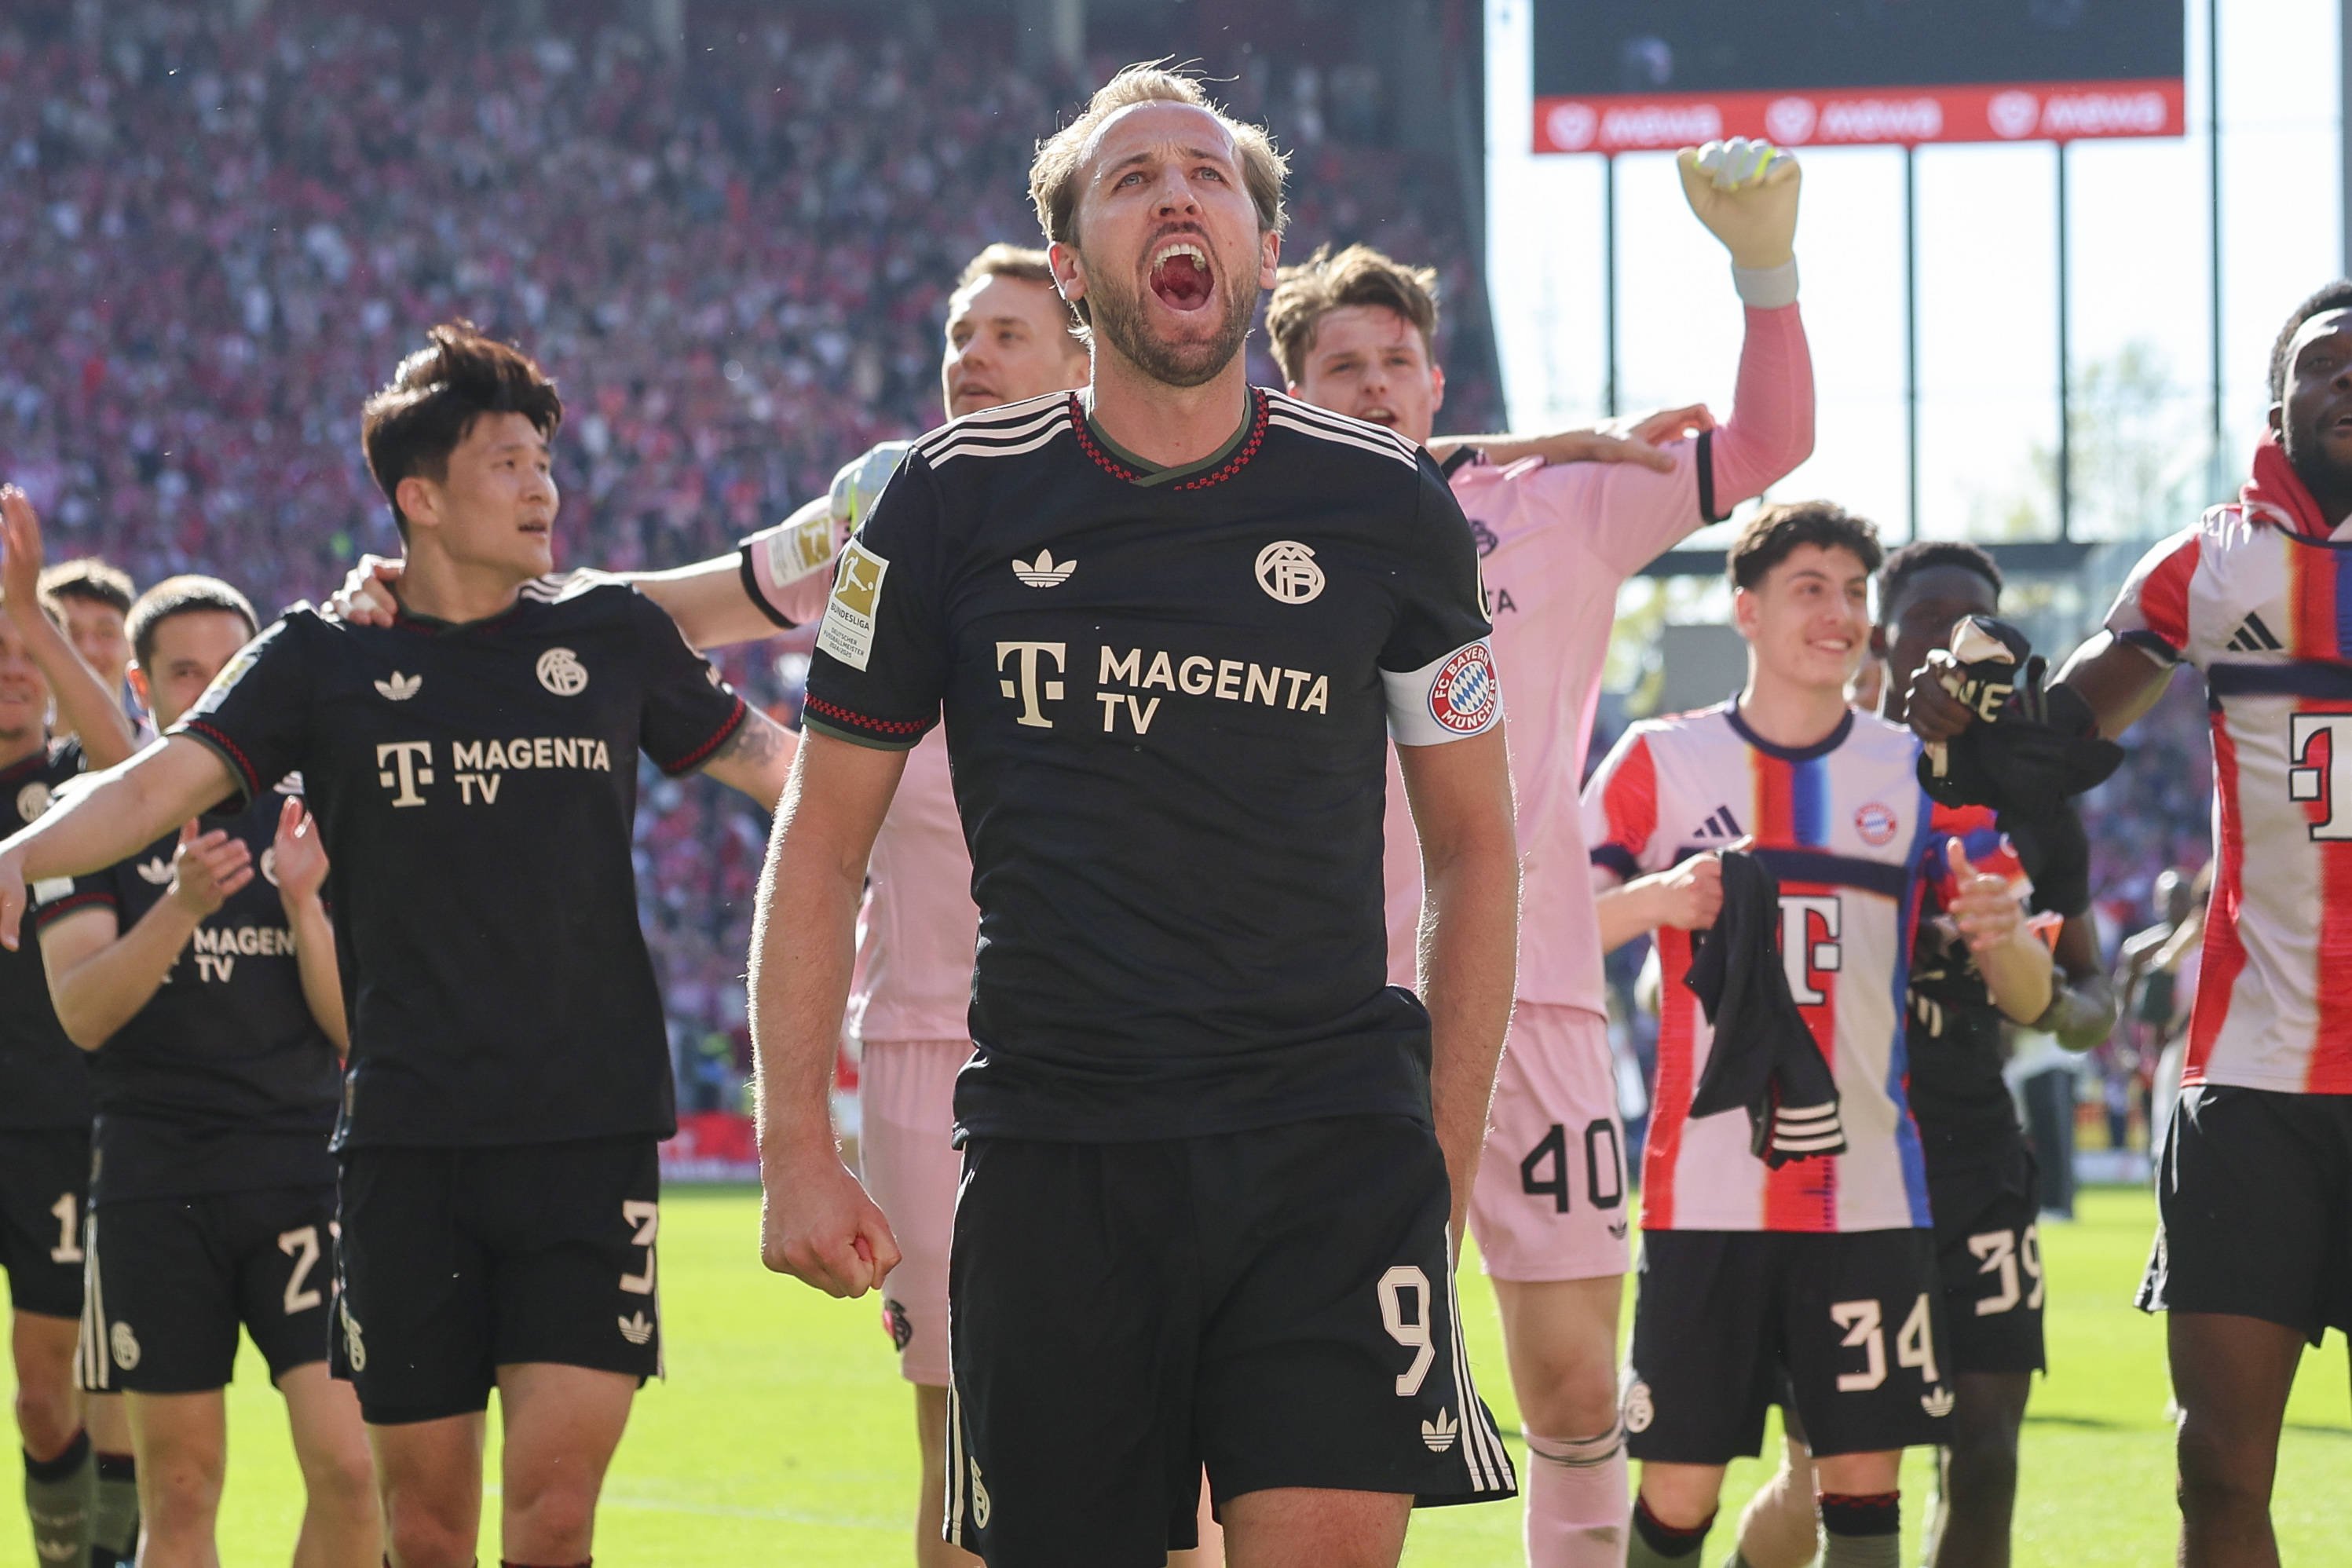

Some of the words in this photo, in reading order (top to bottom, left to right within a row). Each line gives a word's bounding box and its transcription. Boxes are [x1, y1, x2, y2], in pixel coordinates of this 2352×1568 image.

[830, 602, 869, 631] BUNDESLIGA
[831, 627, 858, 645] DEUTSCHER
[996, 641, 1066, 728] T
[1099, 645, 1328, 715] MAGENTA
[1435, 678, 1450, 698] FC
[1446, 647, 1489, 674] BAYERN
[1096, 692, 1160, 735] TV
[1442, 679, 1495, 729] MÜNCHEN
[376, 741, 434, 808] T
[452, 737, 611, 772] MAGENTA
[454, 773, 501, 806] TV
[193, 927, 297, 956] MAGEN
[194, 954, 235, 982] TV
[1520, 1118, 1623, 1214] 40
[50, 1192, 85, 1263] 1
[277, 1219, 342, 1315] 2
[1967, 1223, 2043, 1317] 39
[1377, 1265, 1436, 1397] 9
[1830, 1292, 1940, 1393] 34
